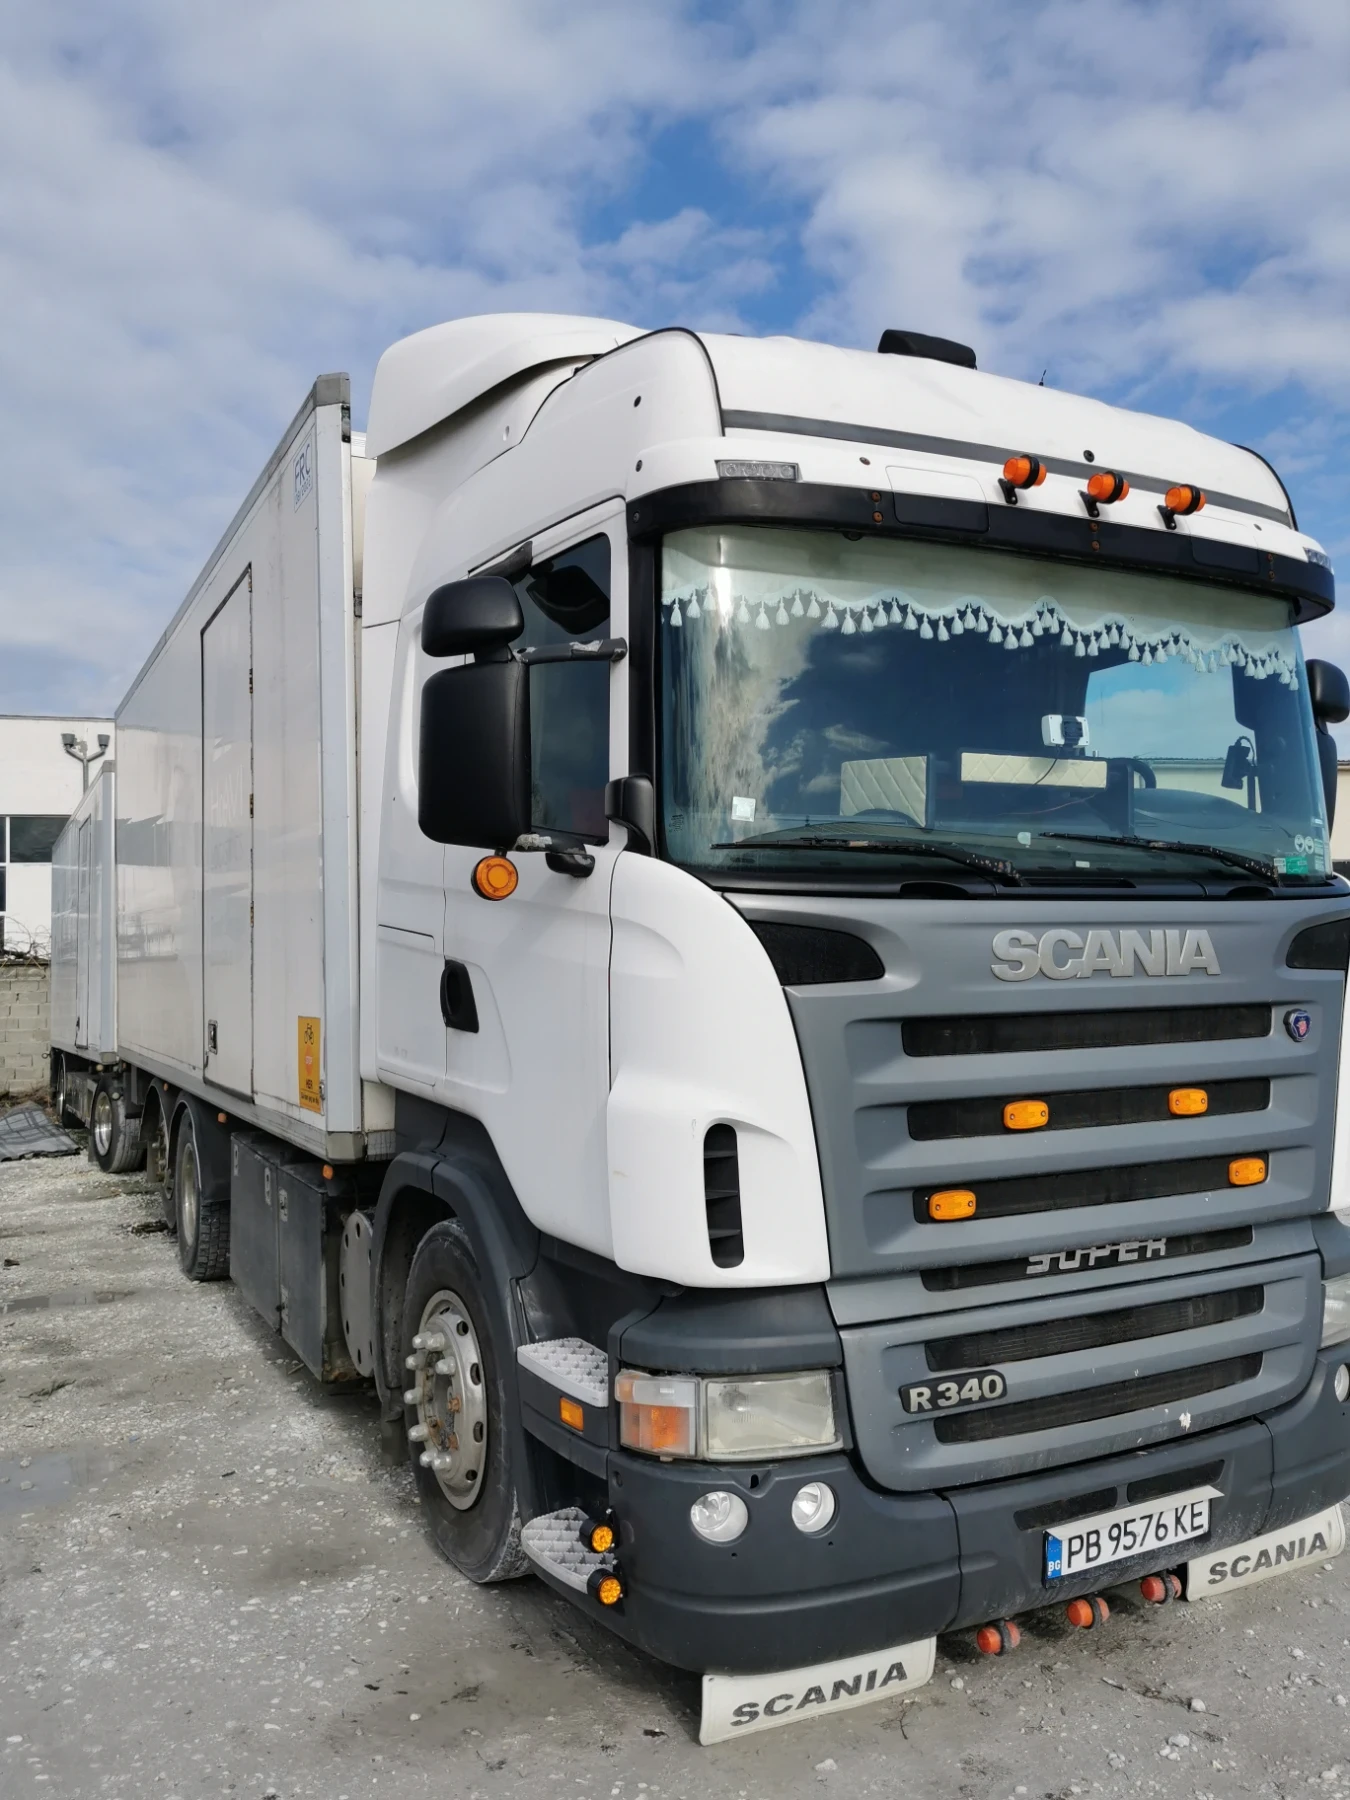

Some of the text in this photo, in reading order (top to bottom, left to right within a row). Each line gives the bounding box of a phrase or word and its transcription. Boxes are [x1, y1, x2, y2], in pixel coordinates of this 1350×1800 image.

[294, 443, 311, 493] FRC
[991, 928, 1221, 982] SCANIA
[909, 1374, 1004, 1412] R 340
[1067, 1500, 1204, 1568] PB 9576 KE
[1207, 1531, 1328, 1585] SCANIA
[1048, 1560, 1061, 1571] BG
[730, 1660, 908, 1727] SCANIA
